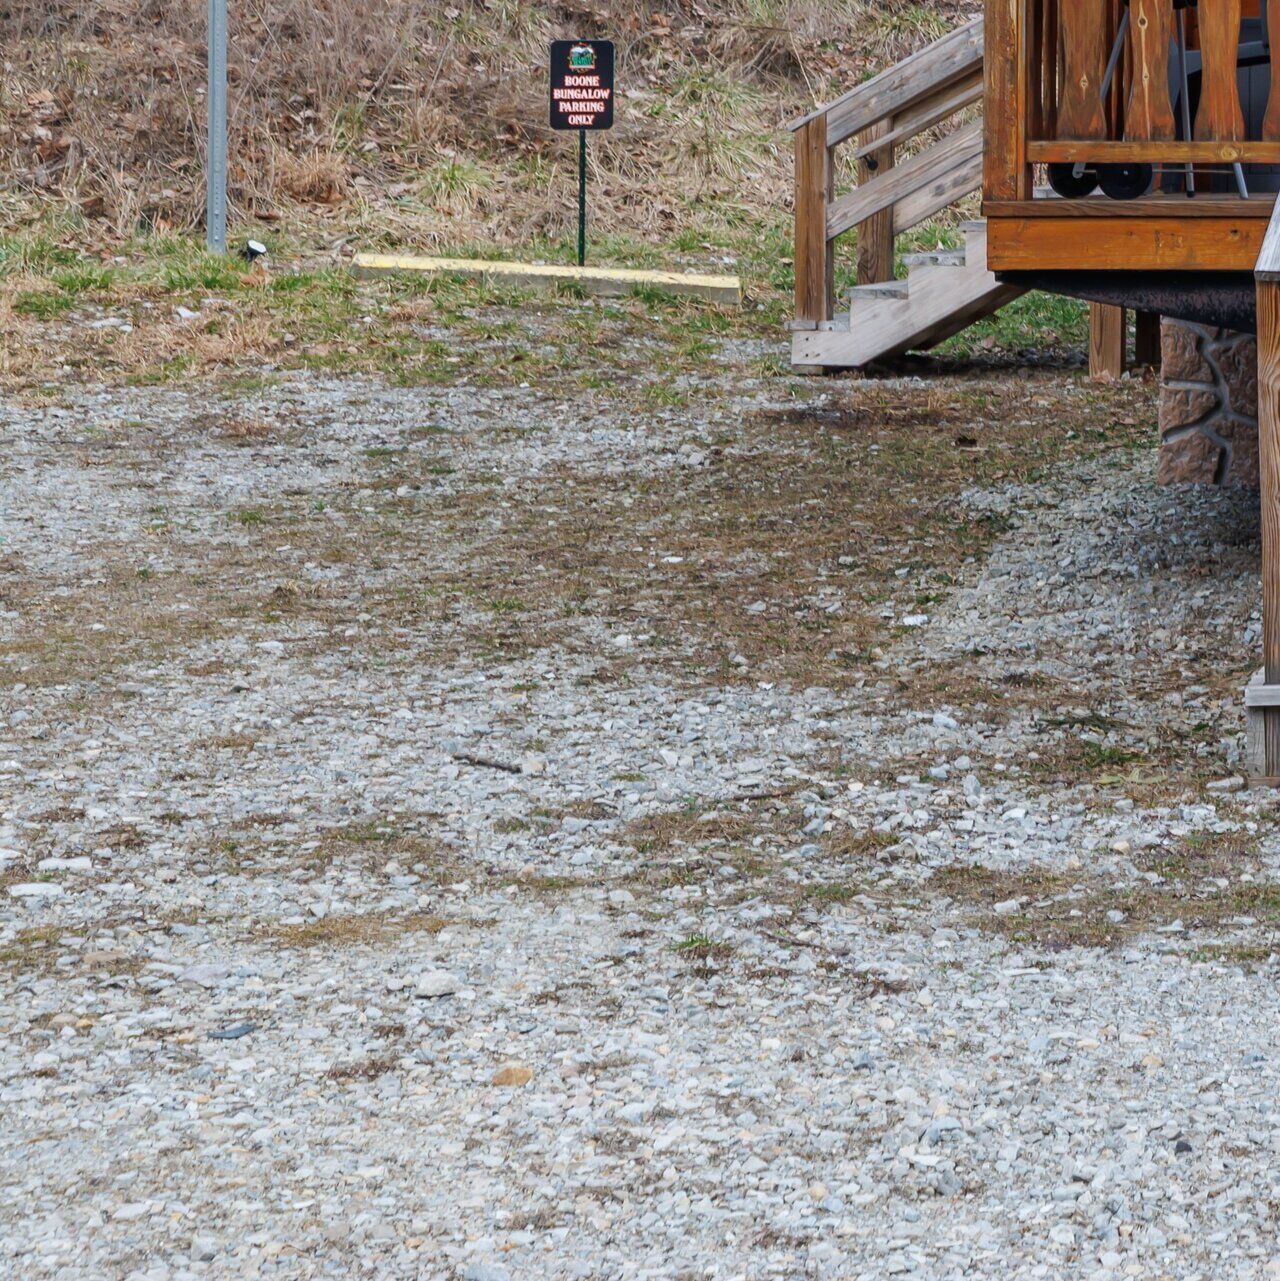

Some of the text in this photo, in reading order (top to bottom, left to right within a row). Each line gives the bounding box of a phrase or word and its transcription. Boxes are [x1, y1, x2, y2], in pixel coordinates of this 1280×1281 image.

[564, 75, 600, 87] BOONE
[553, 88, 611, 100] BUNGALOW
[558, 101, 605, 113] PARKING
[568, 114, 595, 126] ONLY
